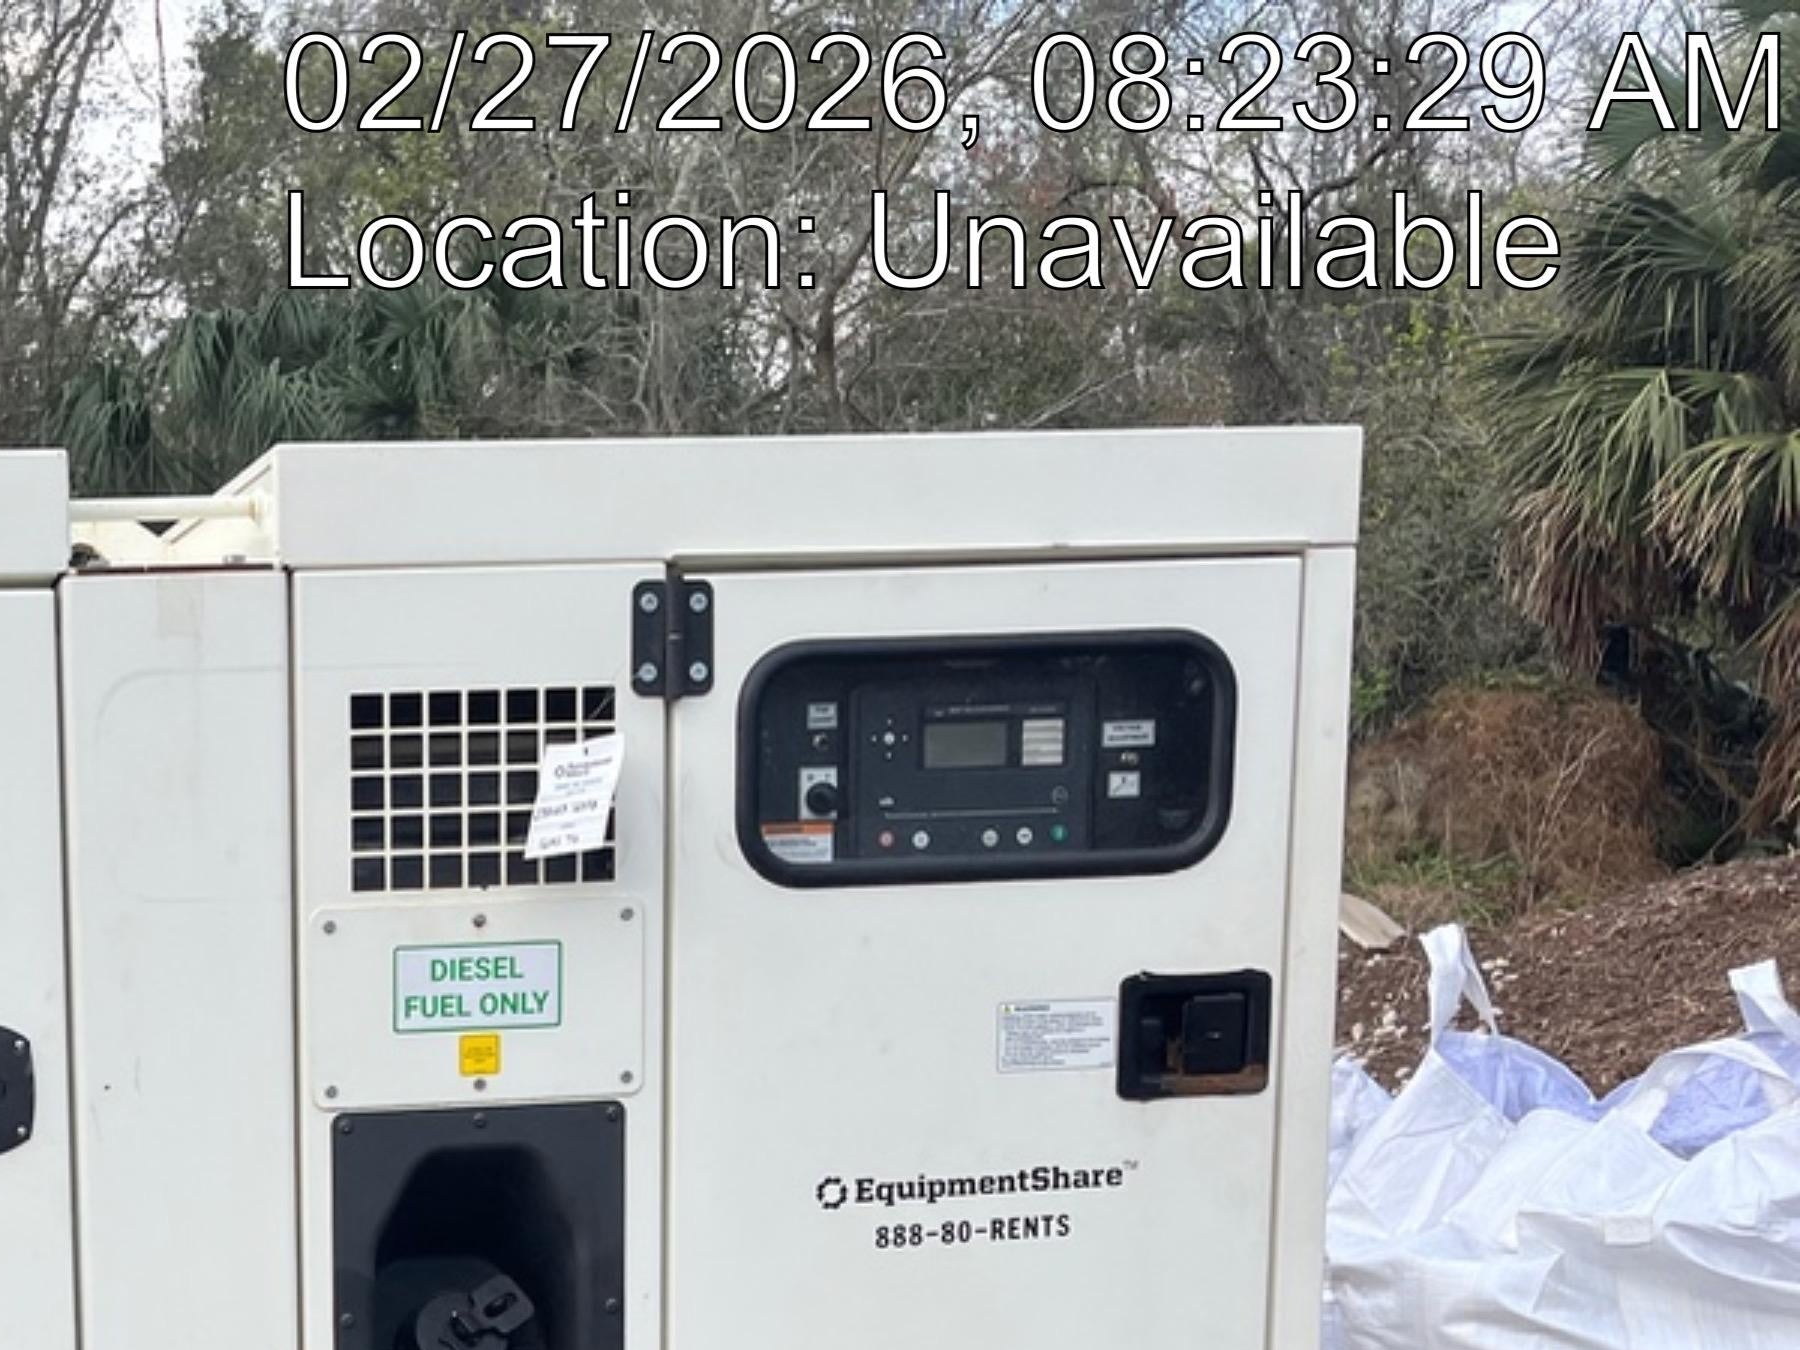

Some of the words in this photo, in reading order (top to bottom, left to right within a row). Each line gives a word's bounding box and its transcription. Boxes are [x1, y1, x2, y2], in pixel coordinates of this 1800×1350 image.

[430, 956, 524, 983] DIESEL
[404, 994, 471, 1019] FUEL
[480, 990, 550, 1016] ONLY
[875, 1214, 1071, 1249] 888-80-RENTS
